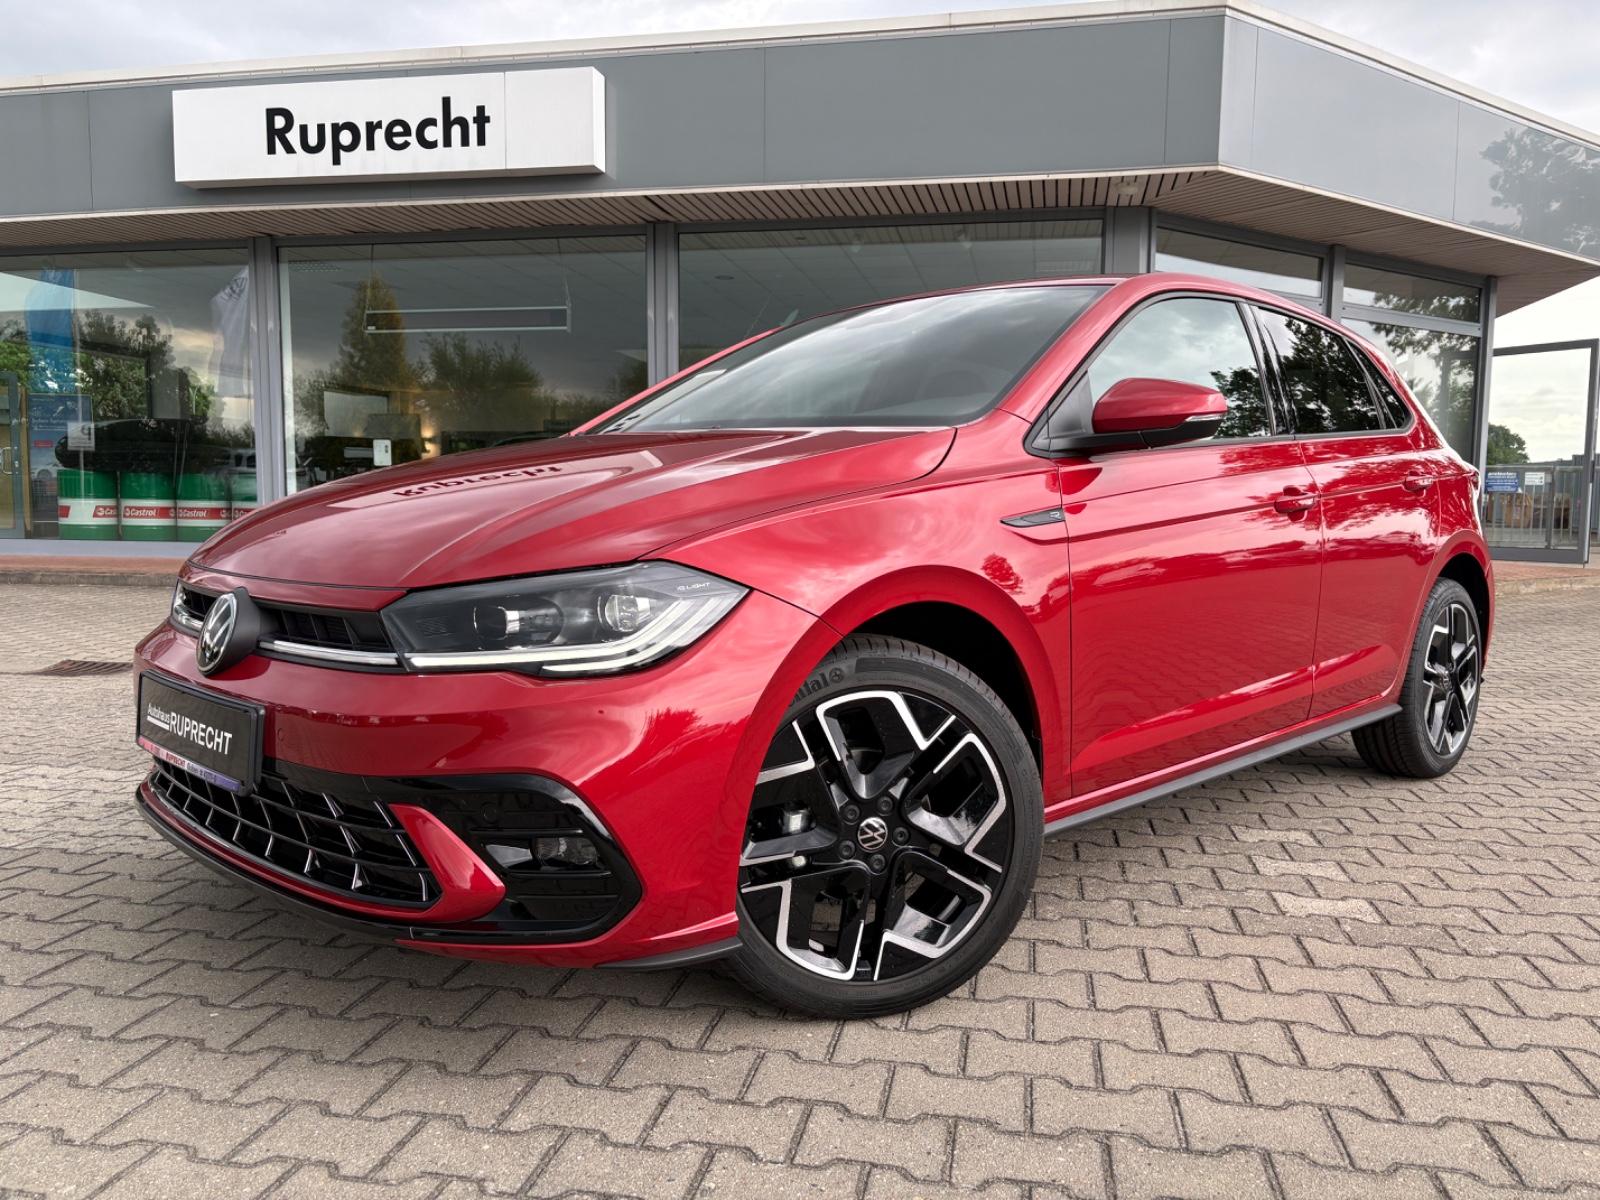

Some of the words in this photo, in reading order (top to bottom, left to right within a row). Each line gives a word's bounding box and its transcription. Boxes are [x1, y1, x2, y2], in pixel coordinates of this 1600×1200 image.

[265, 96, 491, 165] Ruprecht
[129, 507, 157, 517] Castrol
[182, 508, 208, 518] Castrol
[169, 711, 233, 755] RUPRECHT
